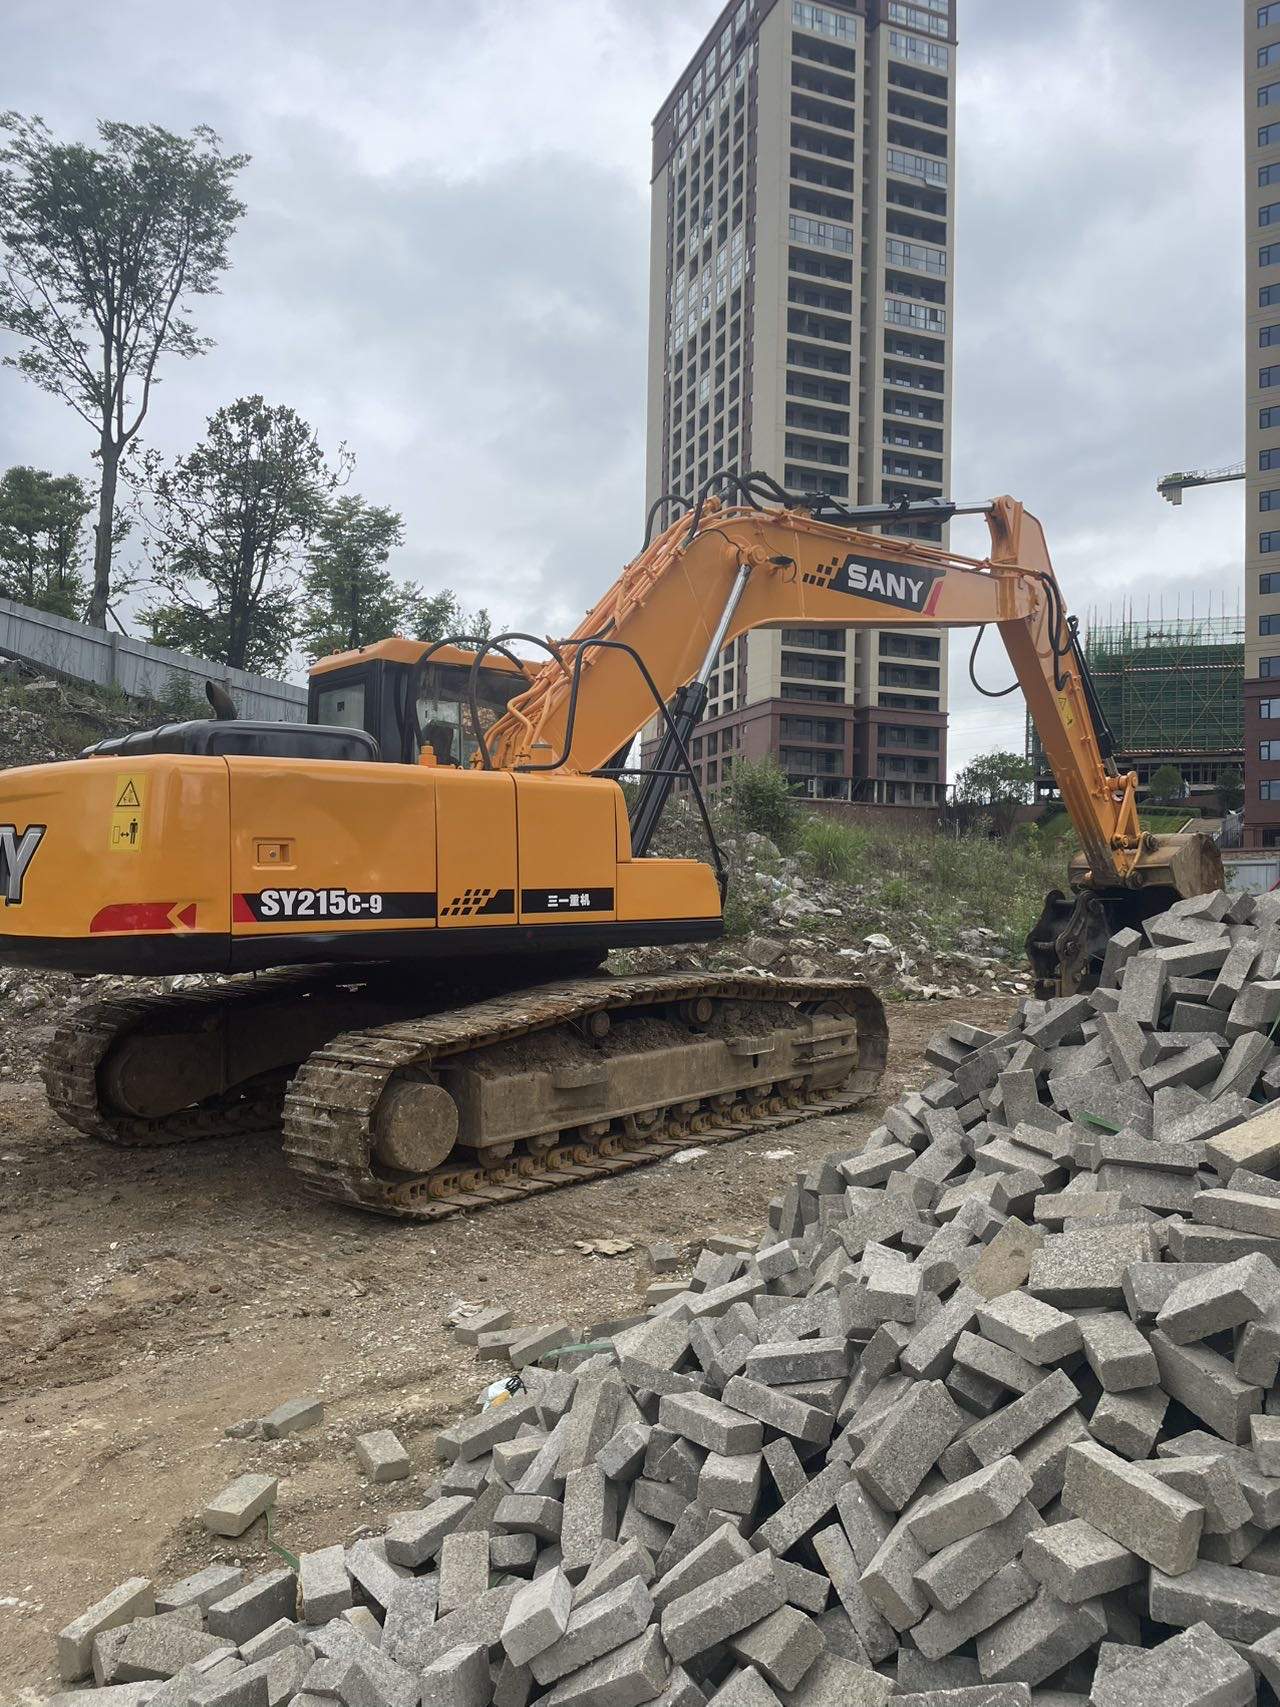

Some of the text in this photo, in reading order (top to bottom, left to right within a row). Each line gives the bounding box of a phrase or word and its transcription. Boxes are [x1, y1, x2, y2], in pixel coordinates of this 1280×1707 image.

[848, 564, 923, 603] SANY
[0, 825, 45, 902] Y
[547, 893, 590, 907] 三一重机
